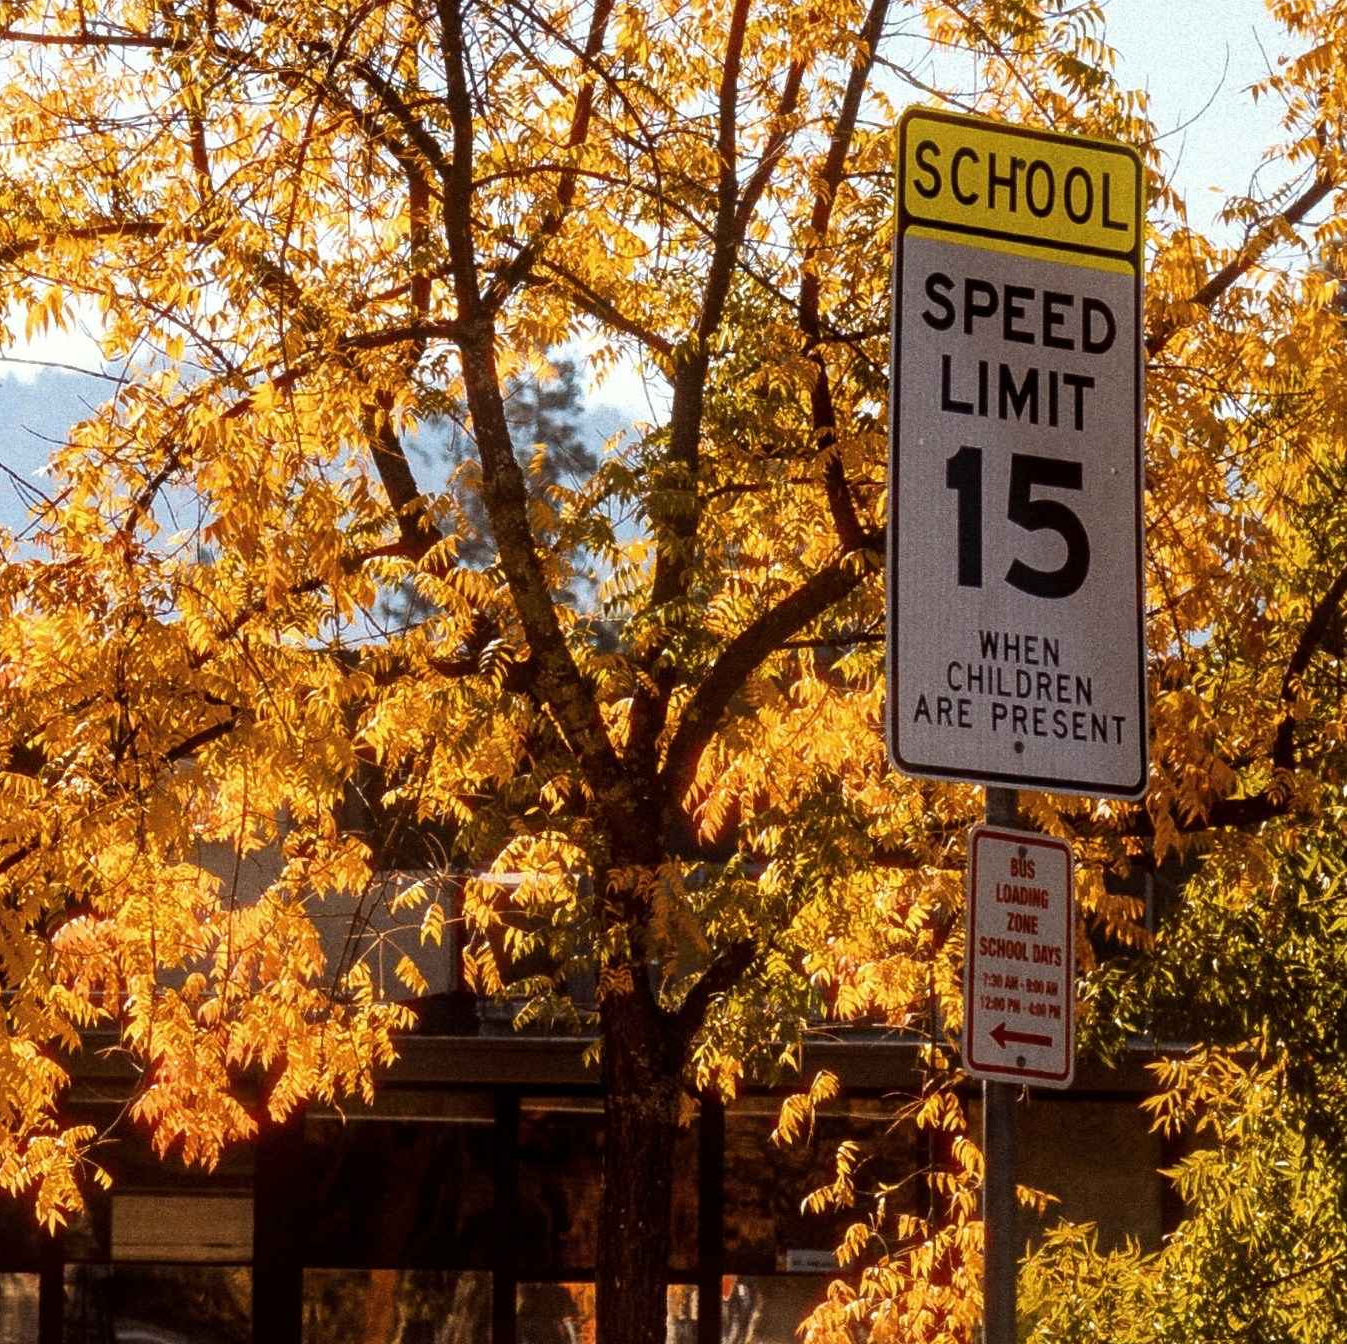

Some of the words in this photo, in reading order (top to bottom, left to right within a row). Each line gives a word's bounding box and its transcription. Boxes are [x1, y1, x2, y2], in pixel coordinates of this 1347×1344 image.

[912, 140, 1129, 232] SCHOOL
[921, 271, 1117, 355] SPEED
[941, 353, 1095, 431] LIMIT
[945, 445, 1091, 599] 15
[978, 629, 1060, 668] WHEN
[947, 661, 1092, 706] CHILDREN
[913, 693, 973, 729] ARE
[991, 701, 1126, 745] PRESENT
[1009, 857, 1036, 880] BUS
[995, 882, 1050, 910] LOADING
[1006, 911, 1039, 936] ZONE
[979, 936, 1029, 962] SCHOOL
[1032, 942, 1063, 967] DAYS
[1004, 975, 1019, 991] AM
[1007, 997, 1021, 1014] PM
[1048, 1004, 1062, 1020] PM
